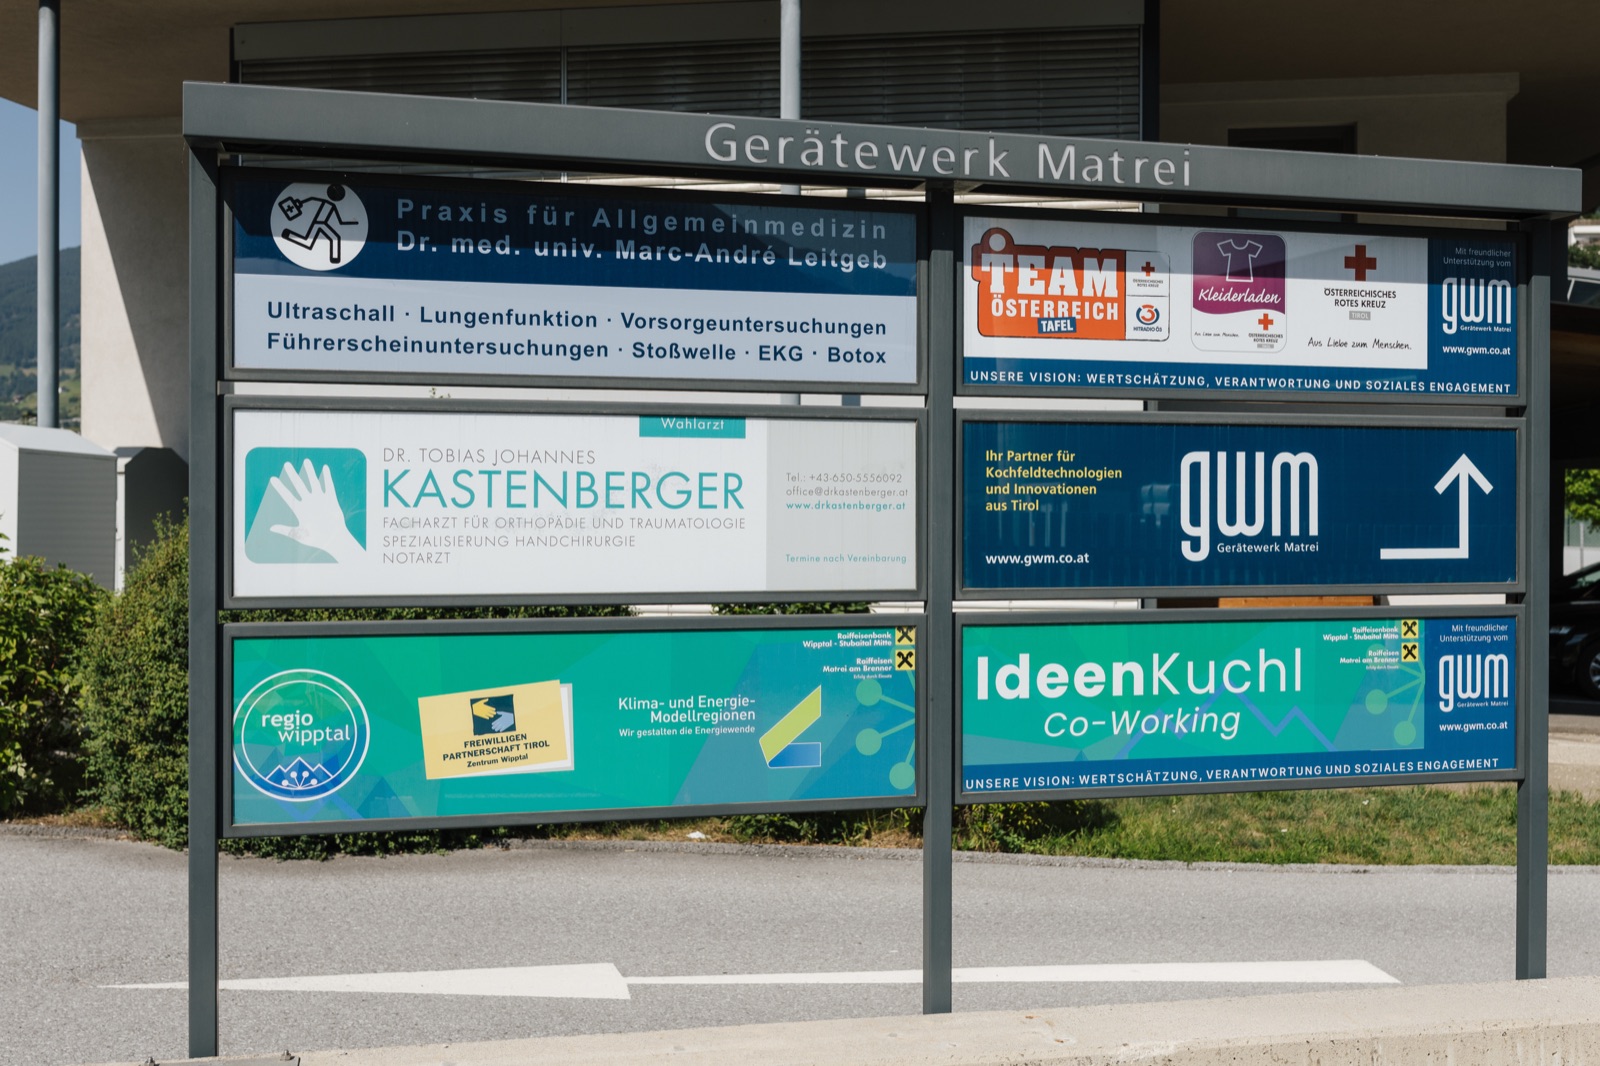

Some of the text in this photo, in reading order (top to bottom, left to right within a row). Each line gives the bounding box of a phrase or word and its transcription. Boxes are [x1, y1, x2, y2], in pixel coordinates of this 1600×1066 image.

[704, 123, 1191, 186] Gerätewerk Matrei
[397, 198, 886, 239] Praxis für Allgemeinmedizin
[397, 231, 887, 273] Dr. med. univ. Marc-André Leitgeb
[1455, 247, 1511, 257] Mit freundlicher
[1443, 257, 1495, 268] Unterstützung
[981, 253, 1118, 298] TEAM
[1198, 286, 1282, 304] Kleiderladen
[1324, 288, 1397, 299] ÖSTERREICHISCHES
[991, 294, 1118, 320] ÖSTERREICH
[1334, 299, 1386, 308] ROTES KREUZ
[1442, 277, 1511, 335] gwm
[268, 301, 886, 338] Ultraschall Lungenfunktion Vorsorgeuntersuchungen
[1041, 319, 1073, 332] TAFEL
[267, 332, 886, 364] Führerscheinuntersuchungen Stoßwelle EKG Botox
[1307, 337, 1322, 347] Aus
[1327, 337, 1348, 347] Liebe
[1372, 338, 1412, 350] Menschen.
[1442, 346, 1511, 356] www.gwm.co.at
[970, 371, 1511, 393] UNSERE VISION: WERTSCHÄTZUNG, VERANTWORTUNG UND SOZIALES ENGAGEMENT
[661, 417, 724, 429] Wahlarzt
[383, 448, 596, 466] DR. TOBIAS JOHANNES
[986, 450, 1075, 462] Ihr Partner für
[786, 472, 902, 483] Tel.: +43-650-5556092
[986, 466, 1122, 480] Kochfeldtechnologien
[384, 468, 744, 509] KASTENBERGER
[786, 486, 908, 499] office@drkastenberger.at
[986, 483, 1097, 495] und Innovationen
[786, 500, 906, 512] www.drkastenberger.at
[986, 499, 1039, 511] aus Tirol
[1180, 451, 1318, 561] gwm
[383, 515, 745, 530] FACHARZT FÜR ORTHOPÄDIE UND TRAUMATOLOGIE
[383, 535, 635, 548] SPEZIALISIERUNG HANDCHIRURGIE
[1217, 542, 1319, 553] Gerätewerk Matrei
[383, 552, 451, 564] NOTARZT
[786, 554, 907, 564] Termine nach Vereinbarung
[986, 553, 1089, 565] www.gwm.co.at
[838, 632, 892, 640] Raiffeisenbank
[1352, 626, 1398, 634] Raiffeisenbank
[803, 640, 832, 649] Wipptal
[840, 639, 872, 647] Stubaital
[1323, 634, 1348, 642] Wipptal
[1440, 635, 1489, 643] Unterstützung
[856, 657, 893, 665] Raiffeisen
[977, 647, 1301, 700] IdeenKuchl
[1439, 654, 1508, 712] gwm
[619, 695, 756, 710] Klima- und Energie-
[262, 710, 314, 730] regio
[650, 709, 756, 724] Modellregionen
[1044, 708, 1240, 740] Co-Working
[1439, 721, 1507, 732] www.gwm.co.at
[277, 725, 351, 745] wipptal
[619, 725, 755, 738] Wir gestalten die Energiewende
[464, 733, 527, 748] FREIWILLIGEN
[443, 740, 550, 761] PARTNERSCHAFT TIROL
[467, 753, 528, 767] Zentrum Wipptal
[965, 758, 1499, 789] UNSERE VISION: WERTSCHÄTZUNG, VERANTWORTUNG UND SOZIALES ENGAGEMENT
